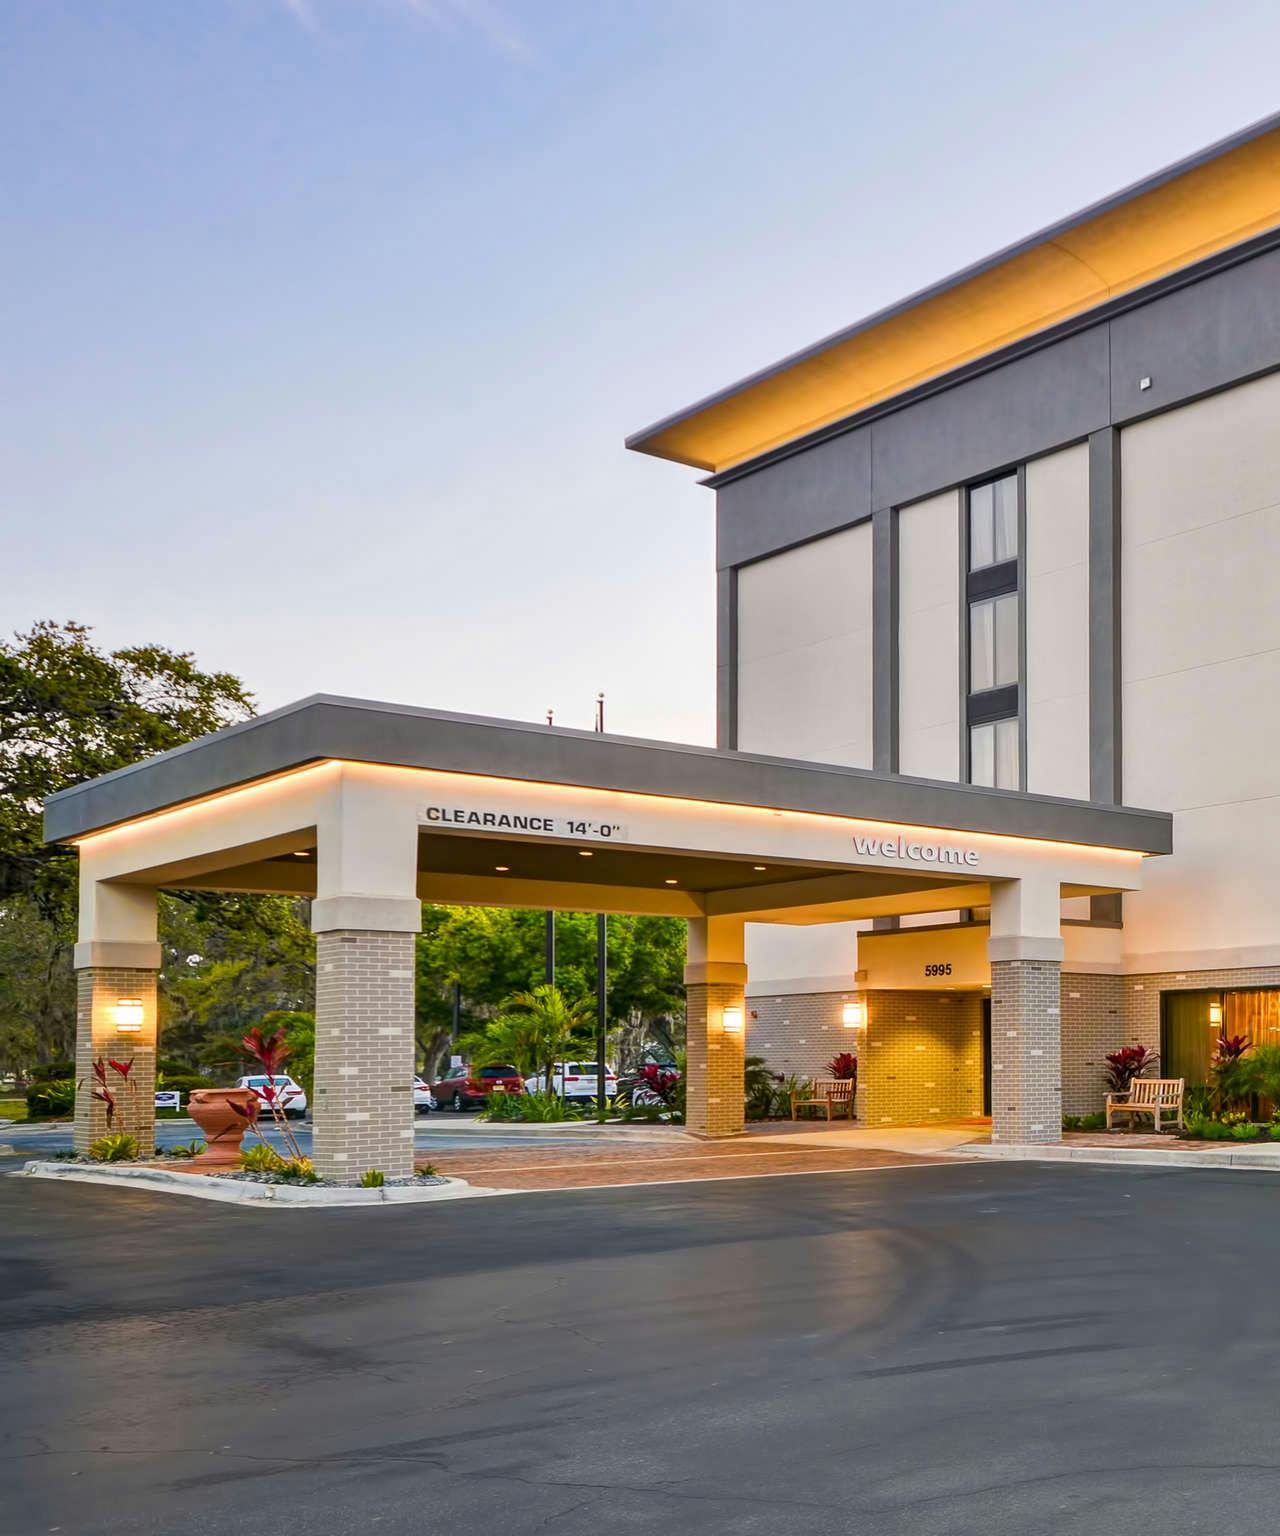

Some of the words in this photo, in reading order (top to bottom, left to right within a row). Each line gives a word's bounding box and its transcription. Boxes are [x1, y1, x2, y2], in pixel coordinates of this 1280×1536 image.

[426, 807, 554, 831] CLEARANCE
[853, 836, 980, 866] welcome
[925, 964, 952, 976] 5995
